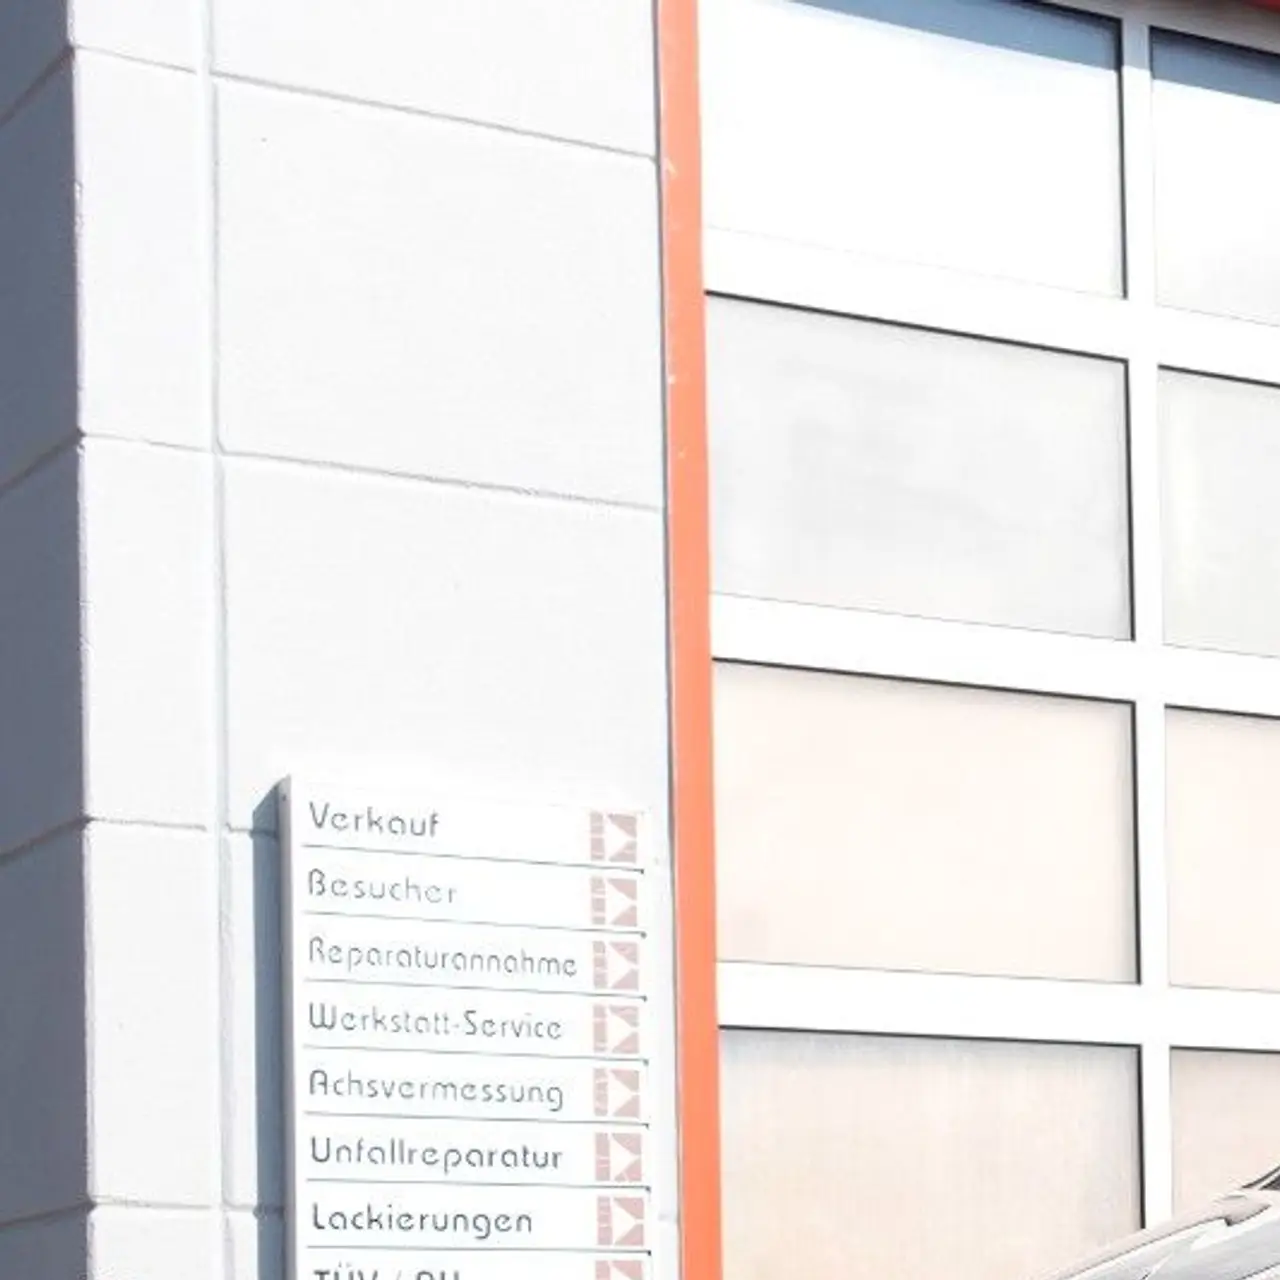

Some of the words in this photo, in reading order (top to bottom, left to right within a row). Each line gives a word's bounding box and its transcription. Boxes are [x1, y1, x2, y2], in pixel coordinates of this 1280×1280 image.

[308, 801, 440, 838] Verkauf
[307, 868, 457, 904] Besucher
[308, 936, 578, 977] Reparaturannahme
[308, 1003, 563, 1040] Werkstatt-Service
[308, 1069, 564, 1112] Achsvermessung
[310, 1136, 564, 1175] Unfallreparatur
[311, 1202, 533, 1240] Lackierungen
